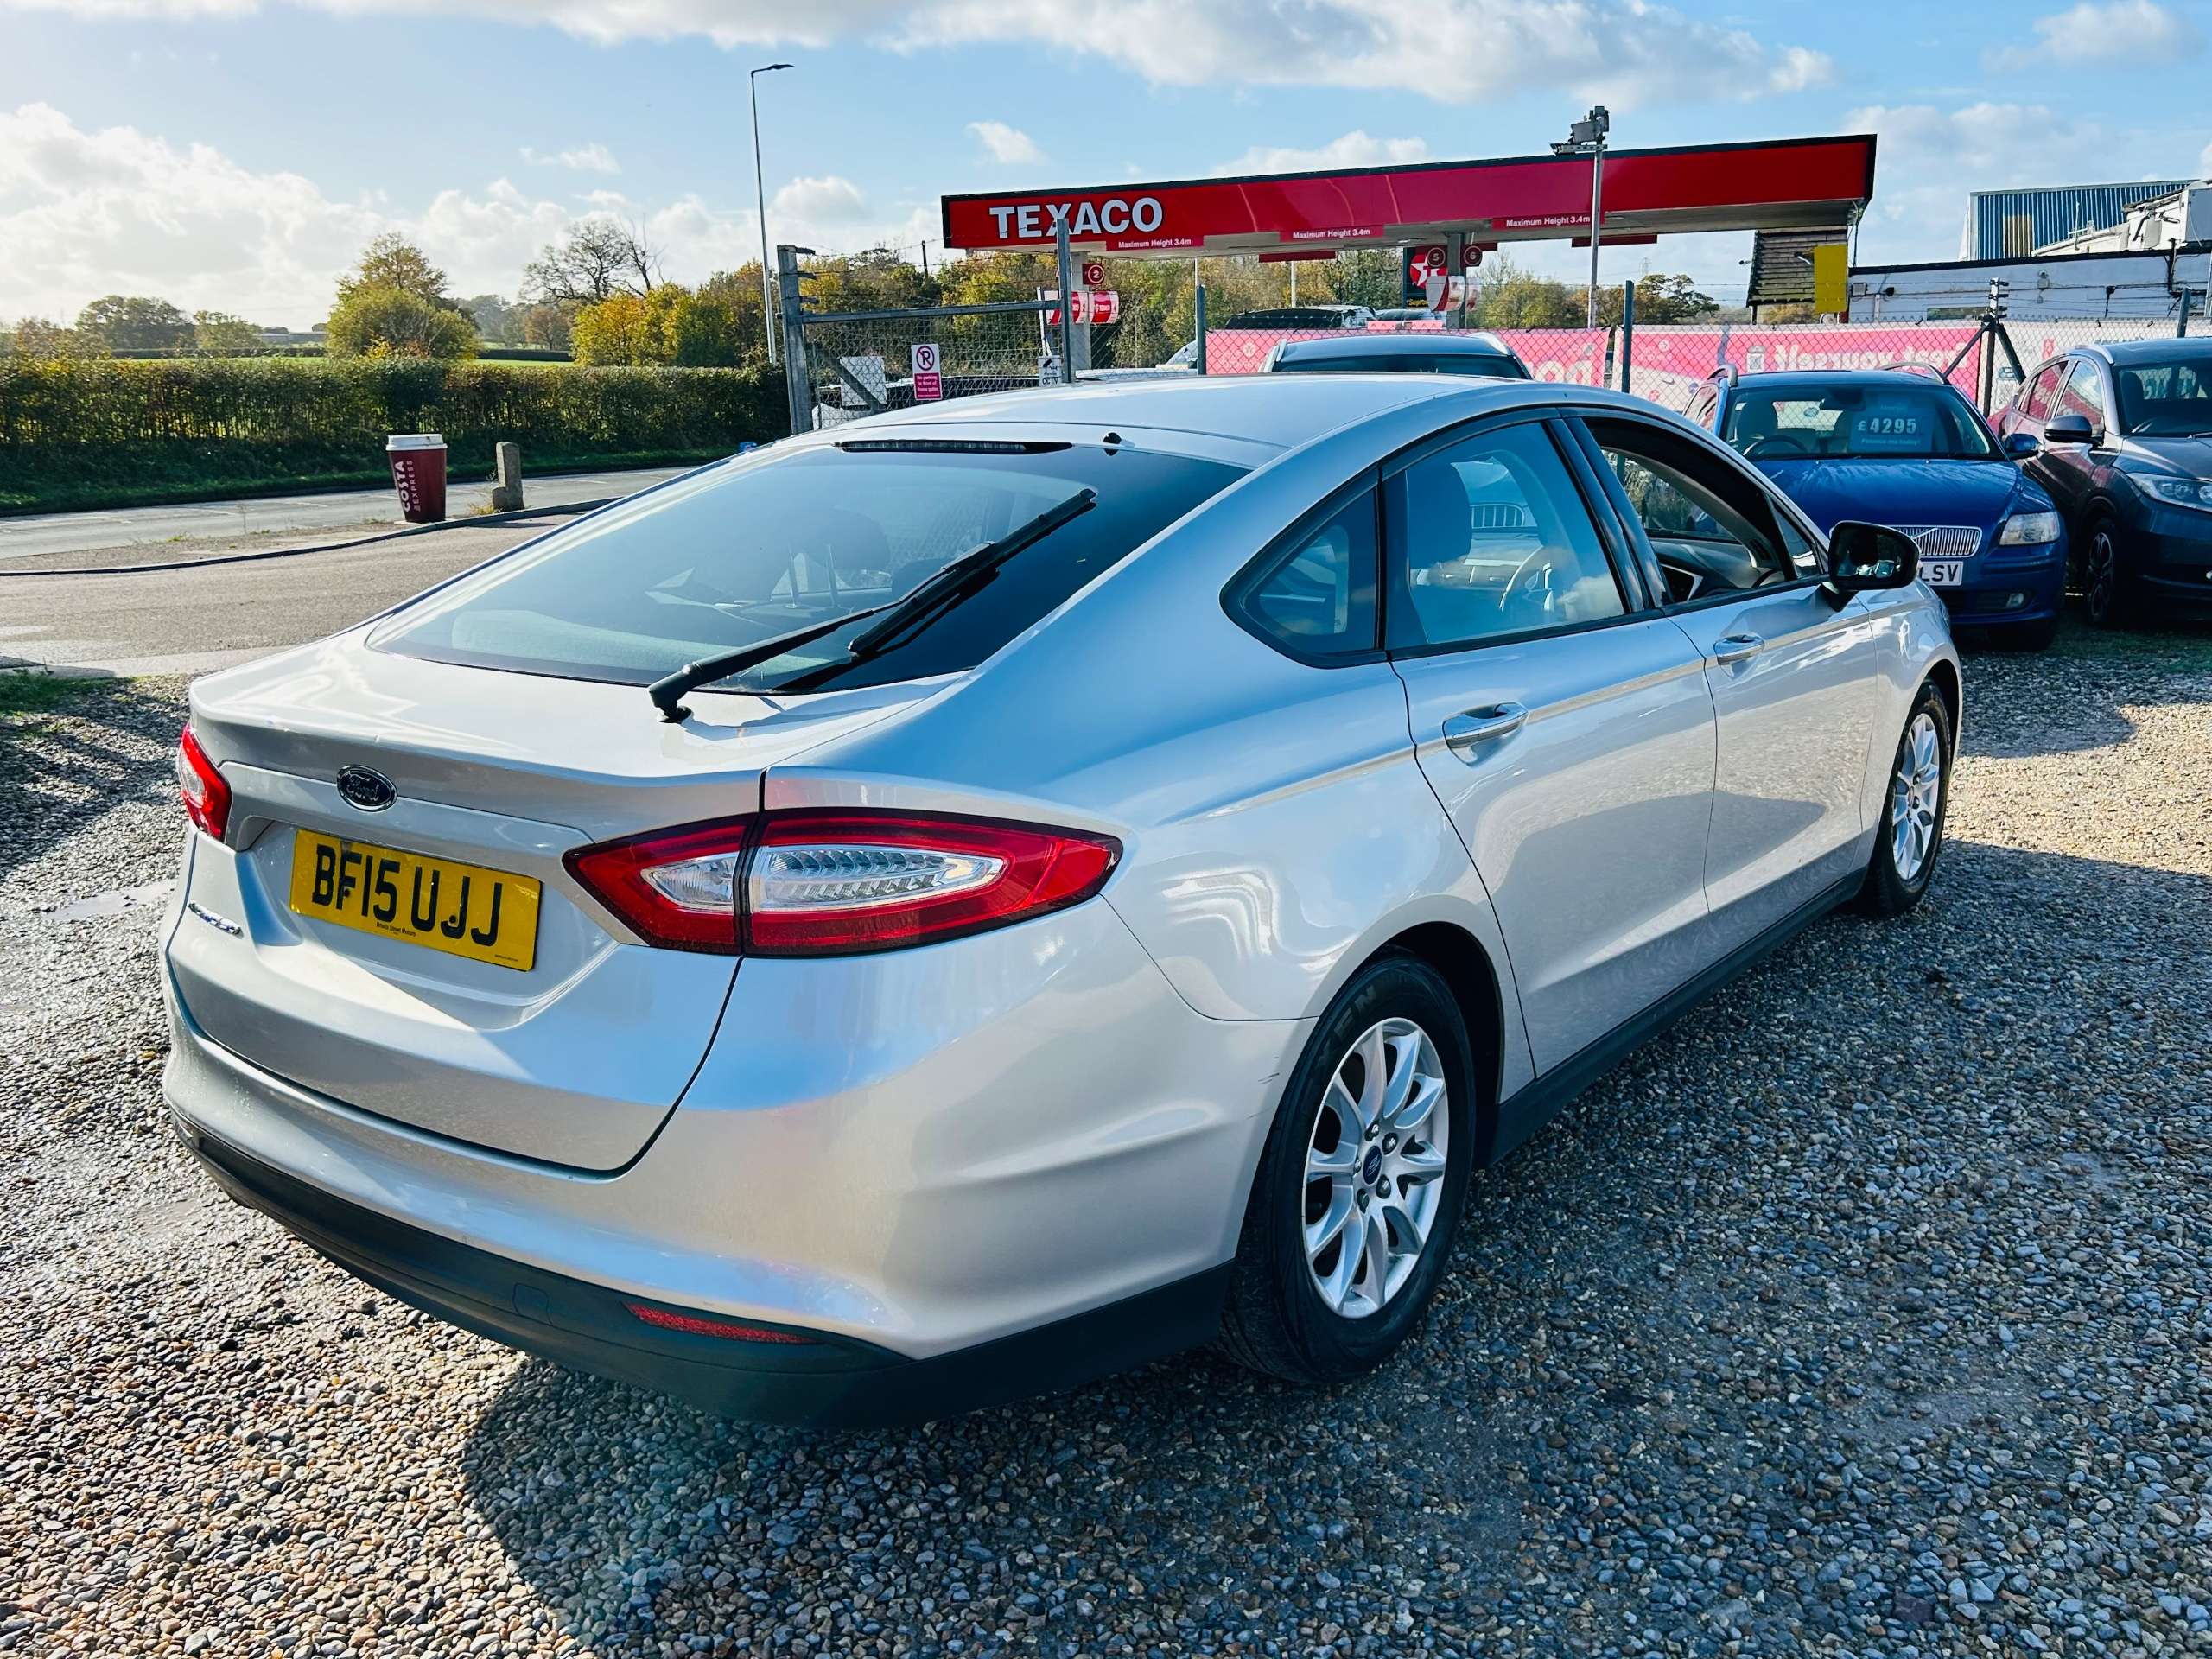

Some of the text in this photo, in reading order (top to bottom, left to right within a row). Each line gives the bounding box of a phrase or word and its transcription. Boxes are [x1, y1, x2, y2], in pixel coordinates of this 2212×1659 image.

[989, 197, 1163, 238] TEXACO
[1506, 215, 1591, 227] Maximum Height 3.4m
[1327, 230, 1351, 238] Height
[1118, 239, 1149, 249] Maximum
[1150, 238, 1173, 248] Height
[1433, 253, 1440, 262] 5
[1469, 251, 1477, 260] 6
[1093, 270, 1100, 278] 2
[395, 461, 410, 512] COSTA
[406, 460, 420, 505] EXPRESS
[410, 864, 503, 947] UJJ
